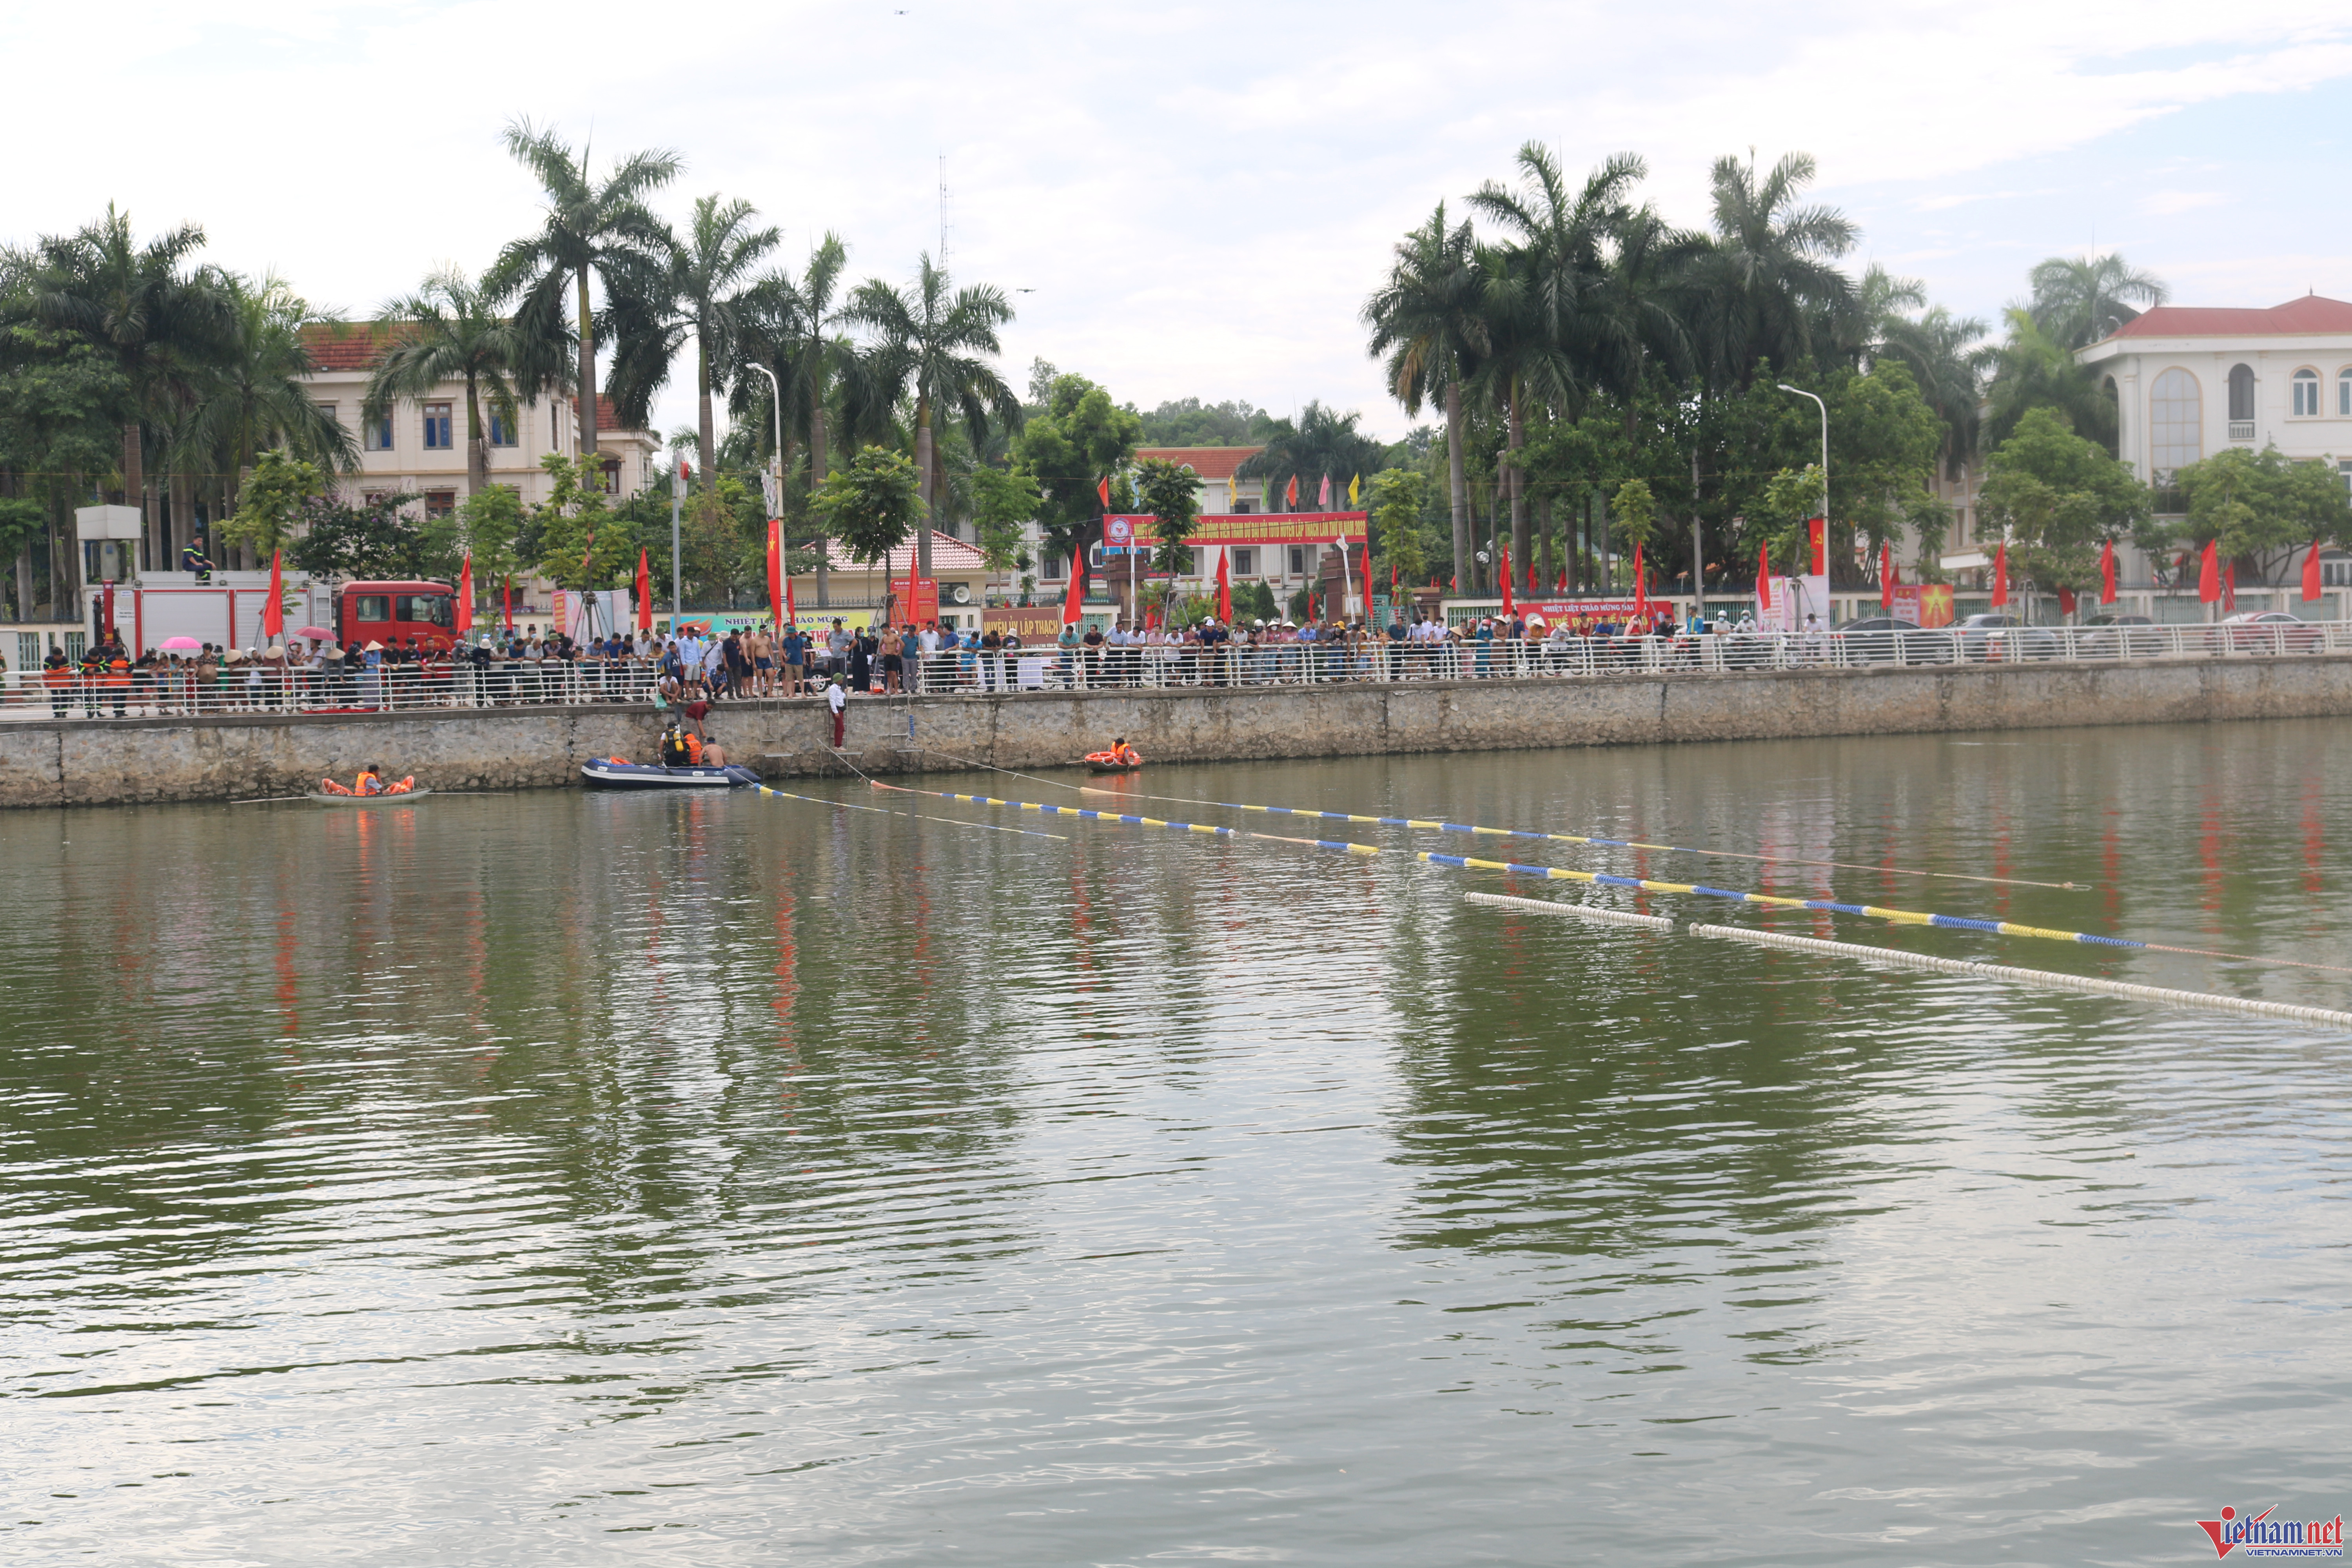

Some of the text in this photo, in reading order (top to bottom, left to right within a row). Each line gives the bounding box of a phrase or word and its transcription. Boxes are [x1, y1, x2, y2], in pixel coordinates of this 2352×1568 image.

[1206, 519, 1219, 542] ĐỘNG
[1220, 519, 1230, 539] VIÊN
[1230, 523, 1244, 538] THAM
[1260, 519, 1268, 541] HỘI
[1280, 519, 1295, 541] HUYỆN
[1295, 518, 1304, 541] LẬP
[1305, 521, 1319, 540] THẠCH
[1319, 515, 1329, 537] LẦN
[1343, 517, 1354, 536] NĂM
[1355, 520, 1366, 536] 2022
[1542, 604, 1563, 613] NHIỆT
[1564, 604, 1579, 613] LIỆT
[1580, 603, 1599, 612] CHÀO
[1600, 603, 1621, 611] MỪNG
[1020, 617, 1034, 638] LẬP
[1035, 620, 1059, 637] THẠCH
